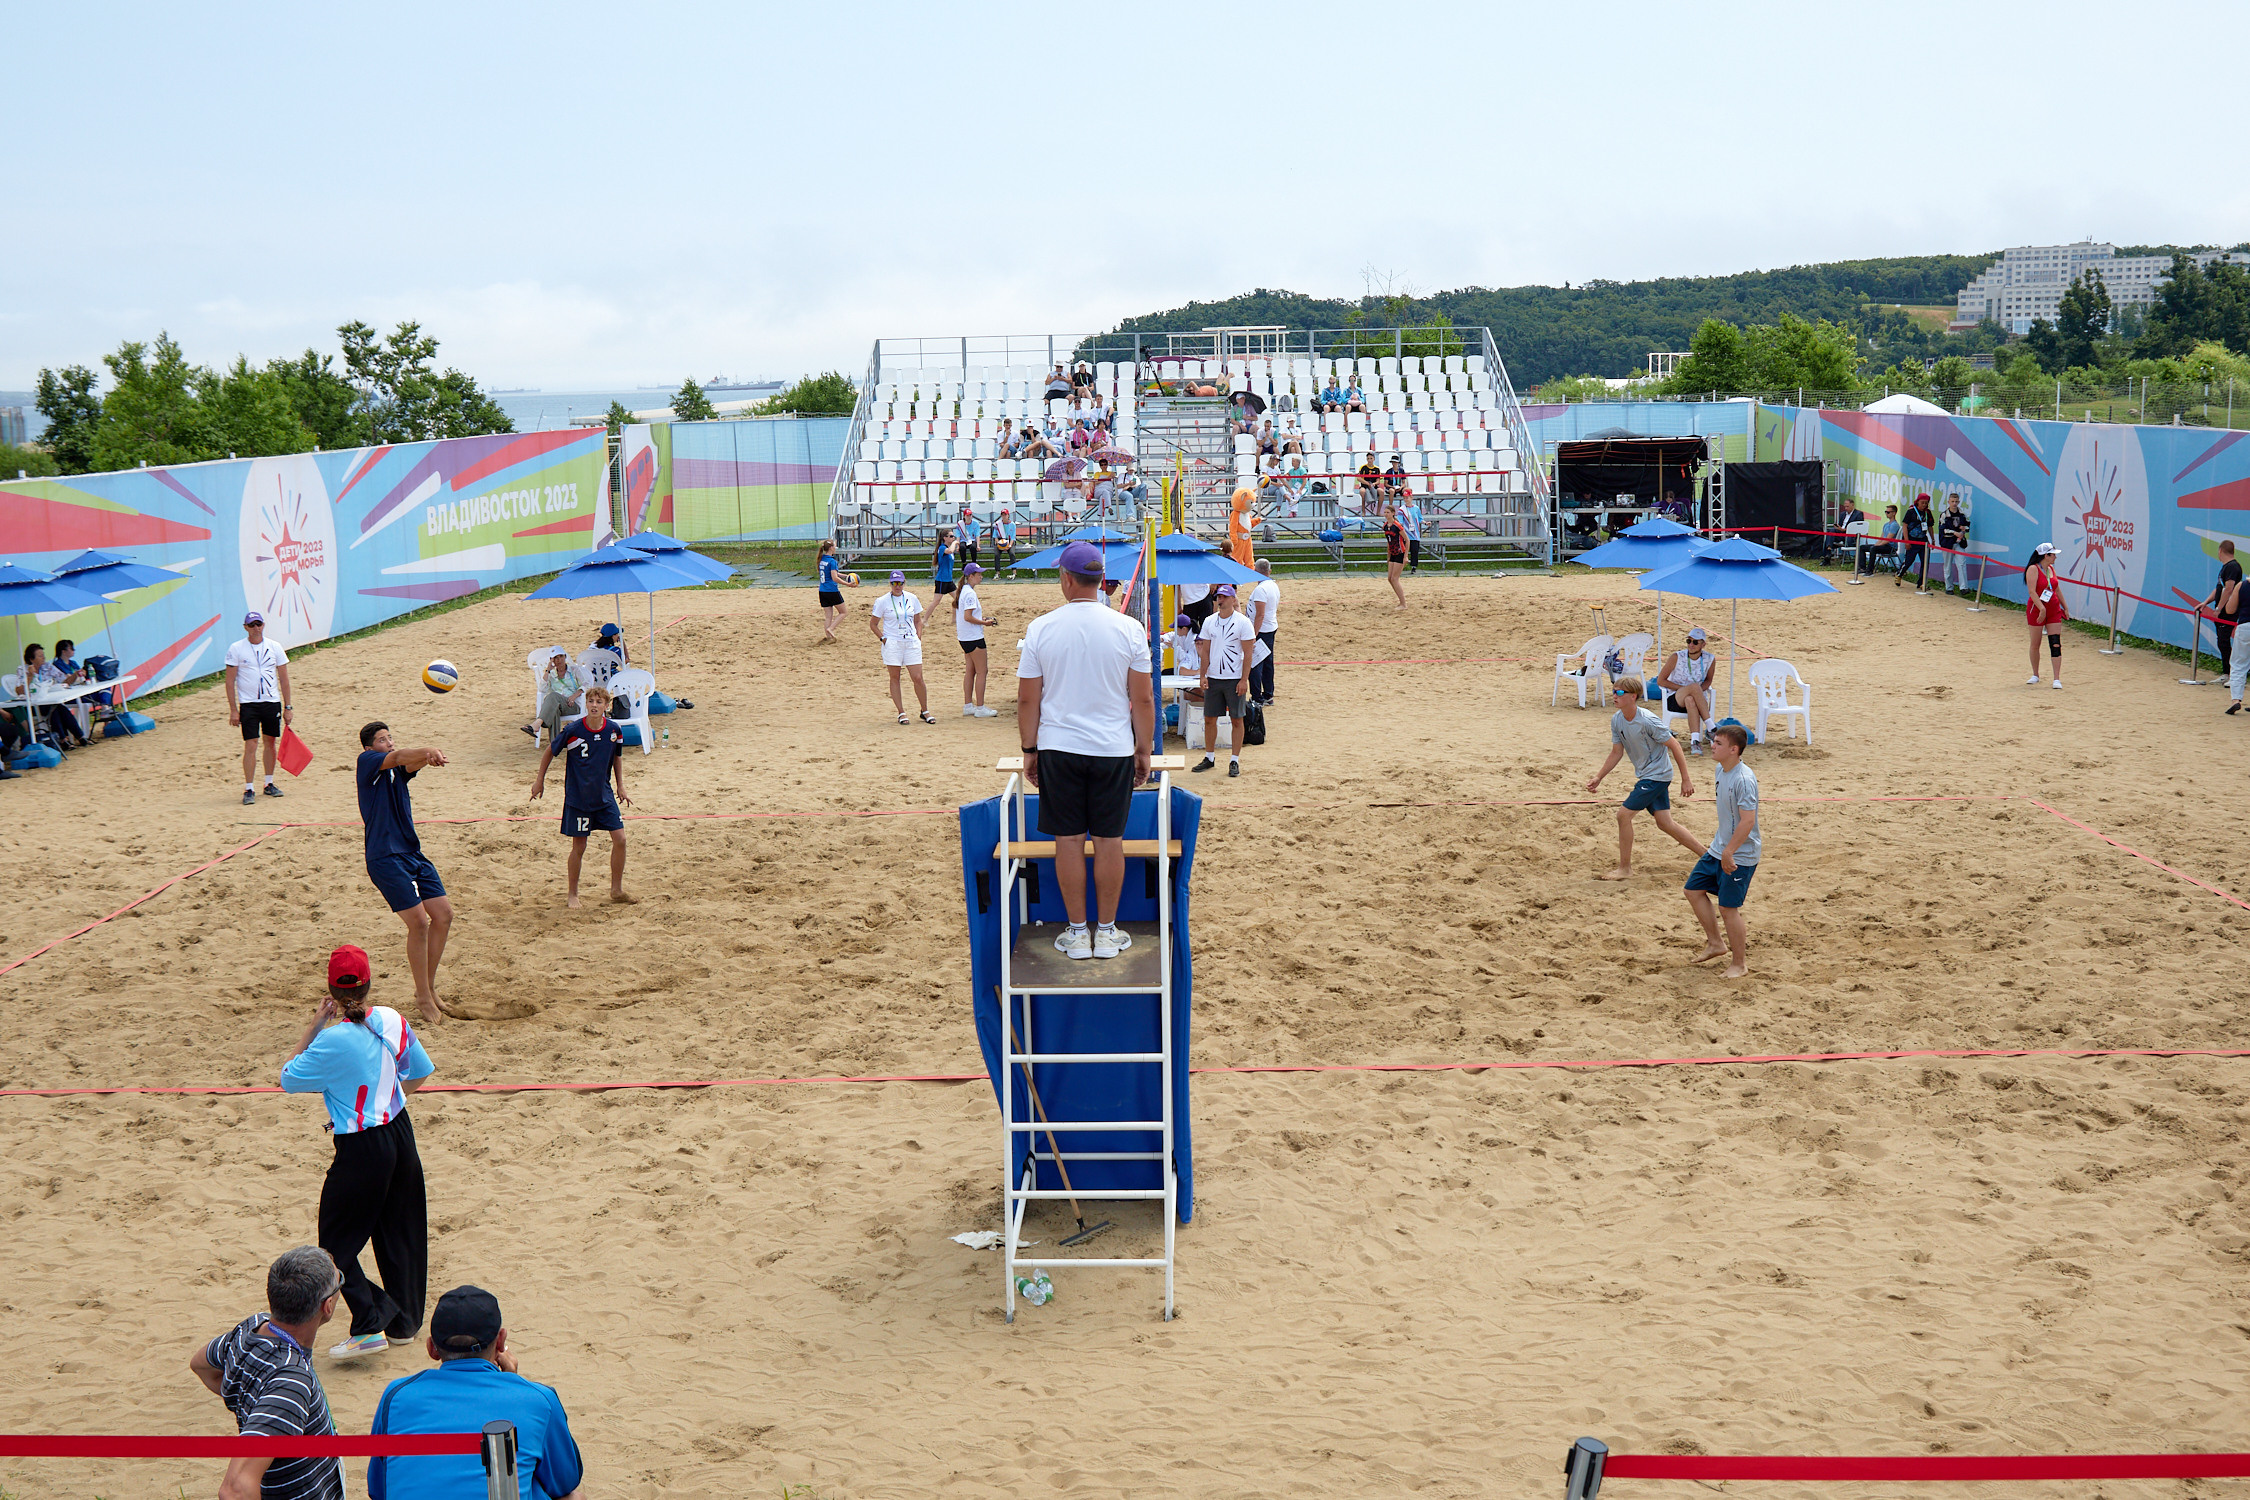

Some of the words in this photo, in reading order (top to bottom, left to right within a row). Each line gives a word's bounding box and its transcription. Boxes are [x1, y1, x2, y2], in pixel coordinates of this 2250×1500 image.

[427, 487, 541, 536] ВЛАДИВОСТОК
[544, 483, 578, 513] 2023
[2087, 516, 2110, 531] ДЕТИ
[2112, 520, 2134, 535] 2023
[280, 543, 301, 561] ДЕТИ
[303, 540, 323, 554] 2023
[2088, 532, 2133, 552] ПРИМОРЬЯ
[281, 555, 324, 575] ПРИМОРЬЯ
[581, 743, 589, 757] 2
[577, 817, 590, 831] 12
